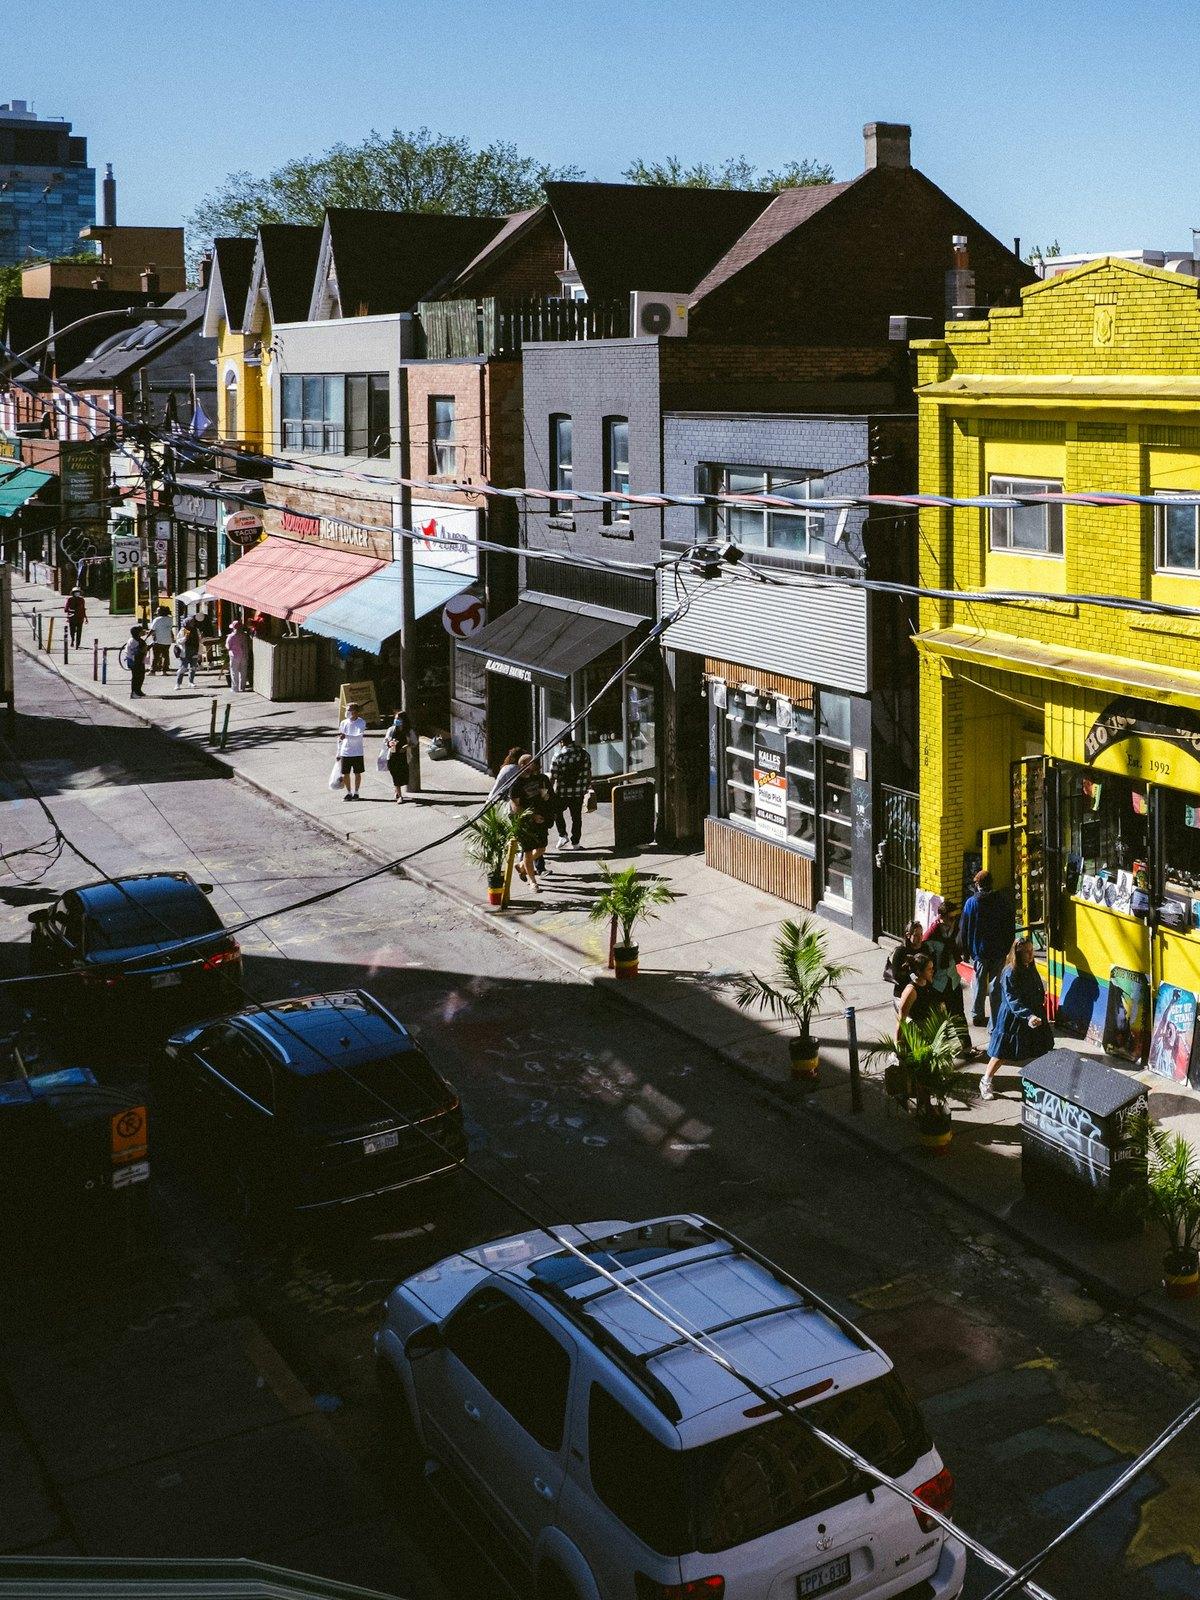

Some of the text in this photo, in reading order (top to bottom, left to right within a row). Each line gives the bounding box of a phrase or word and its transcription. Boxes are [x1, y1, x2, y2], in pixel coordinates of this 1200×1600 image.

[118, 550, 140, 564] 30
[758, 749, 781, 766] KALLES
[1149, 759, 1171, 776] 1992
[758, 771, 776, 787] SOLD
